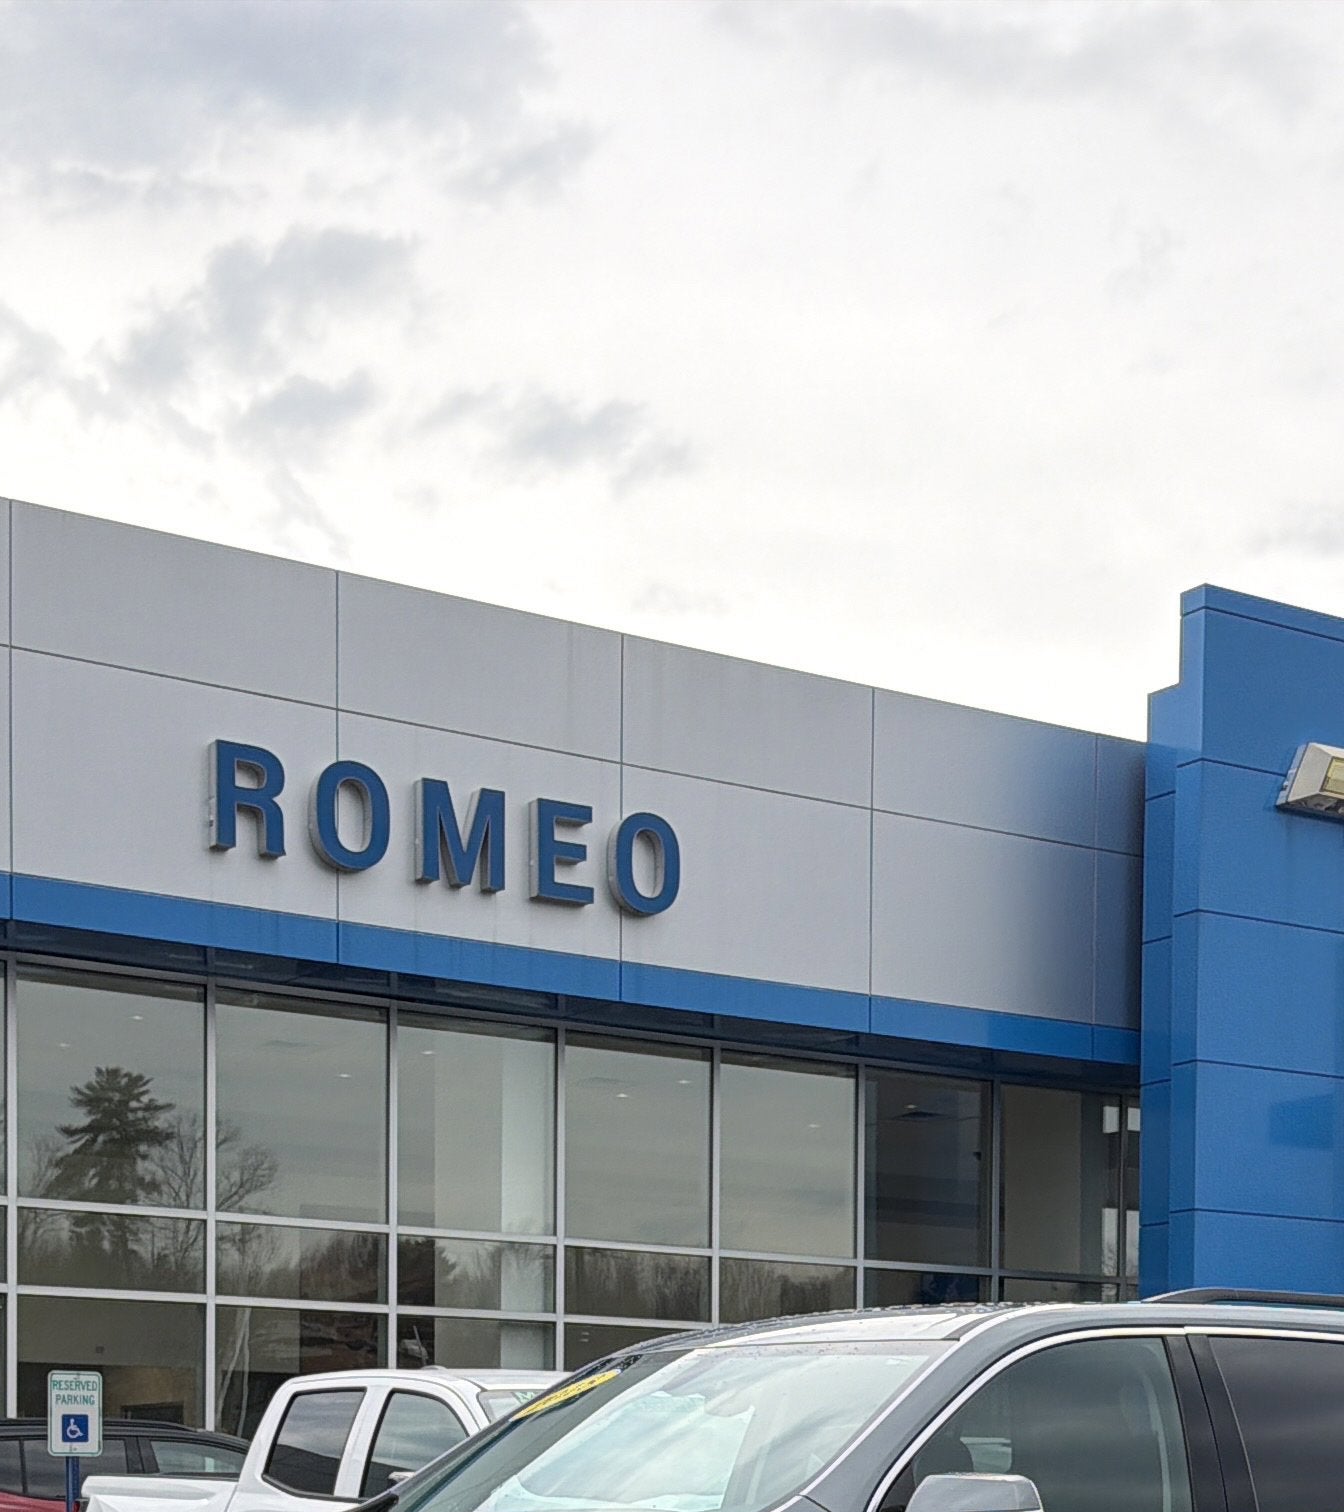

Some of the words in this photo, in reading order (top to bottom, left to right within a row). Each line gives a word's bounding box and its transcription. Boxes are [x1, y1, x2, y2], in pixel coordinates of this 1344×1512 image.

[208, 739, 680, 917] ROMEO
[52, 1380, 97, 1392] RESERVED
[56, 1394, 96, 1406] PARKING
